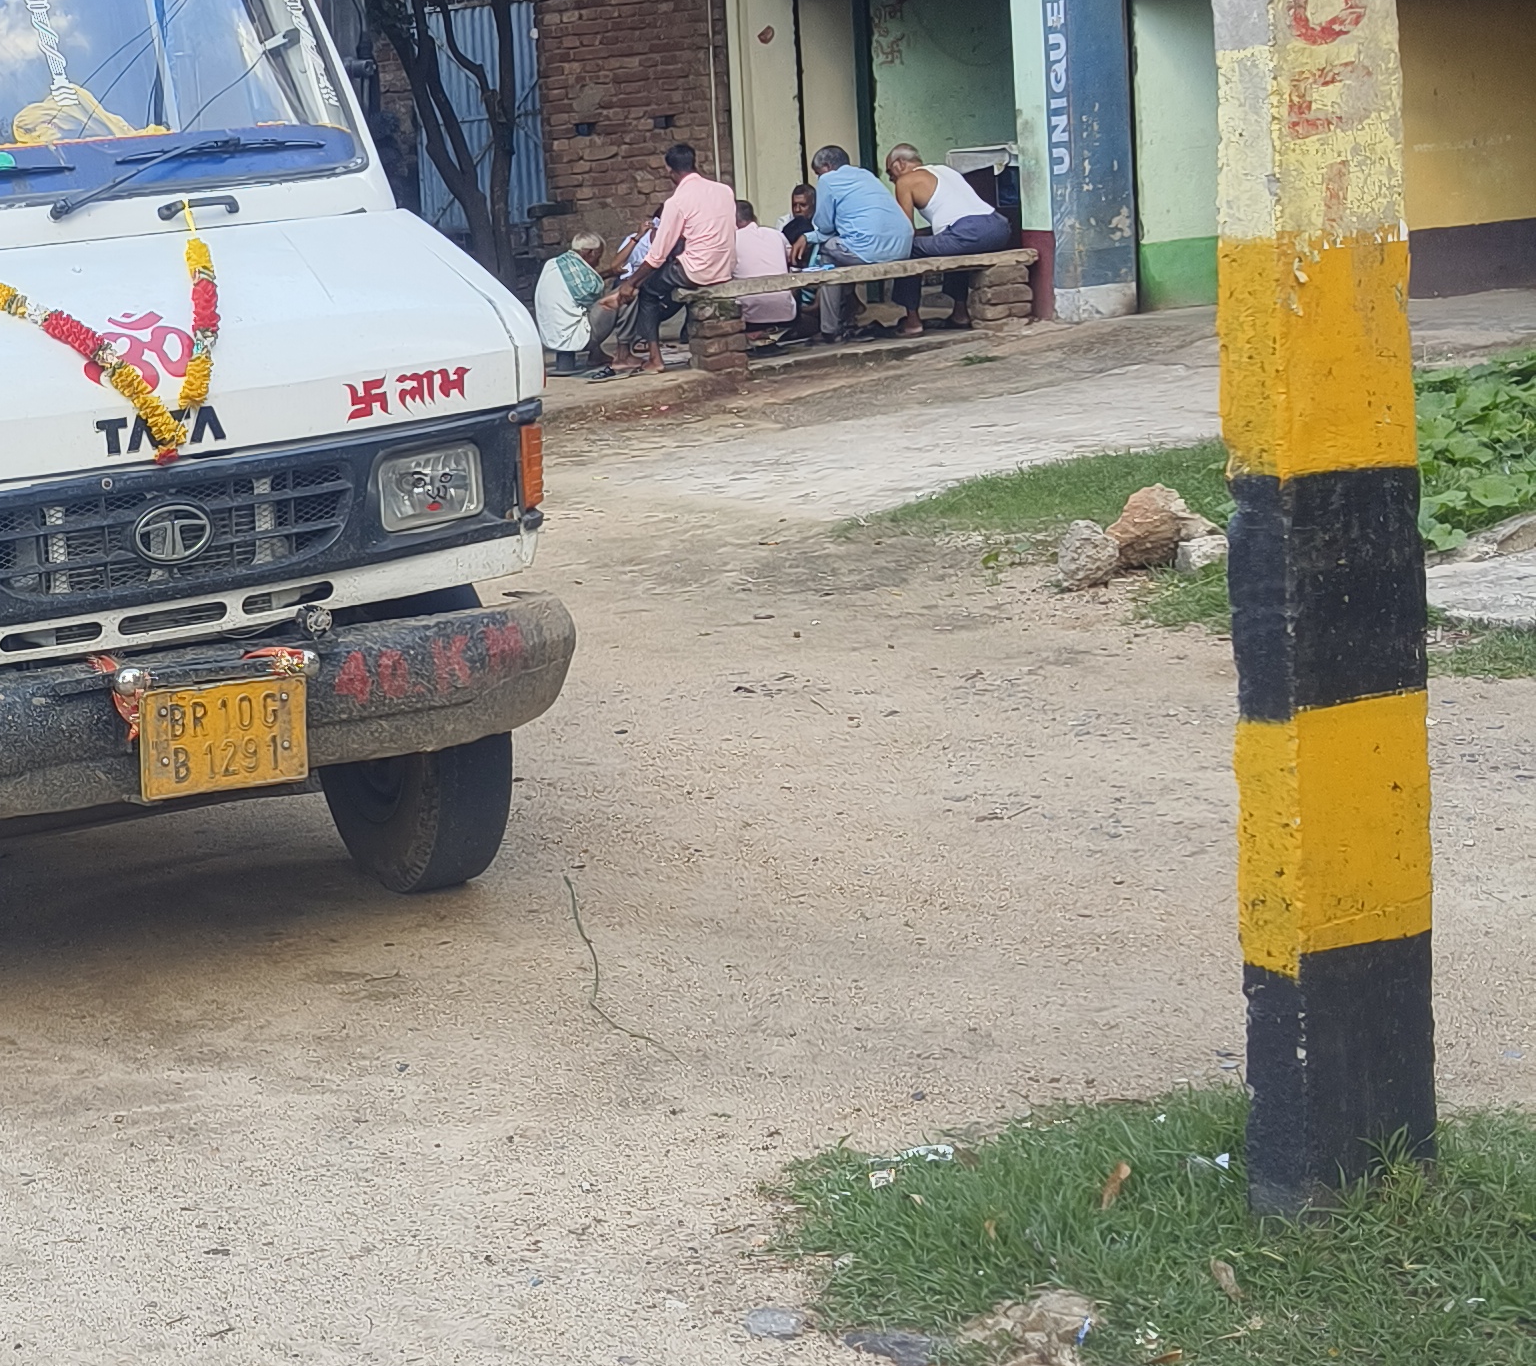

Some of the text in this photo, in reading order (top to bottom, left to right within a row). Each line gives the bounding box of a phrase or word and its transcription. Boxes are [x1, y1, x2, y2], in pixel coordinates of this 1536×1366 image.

[1046, 0, 1071, 175] UNIQUE
[397, 365, 472, 414] लाभ
[93, 404, 227, 457] TAA
